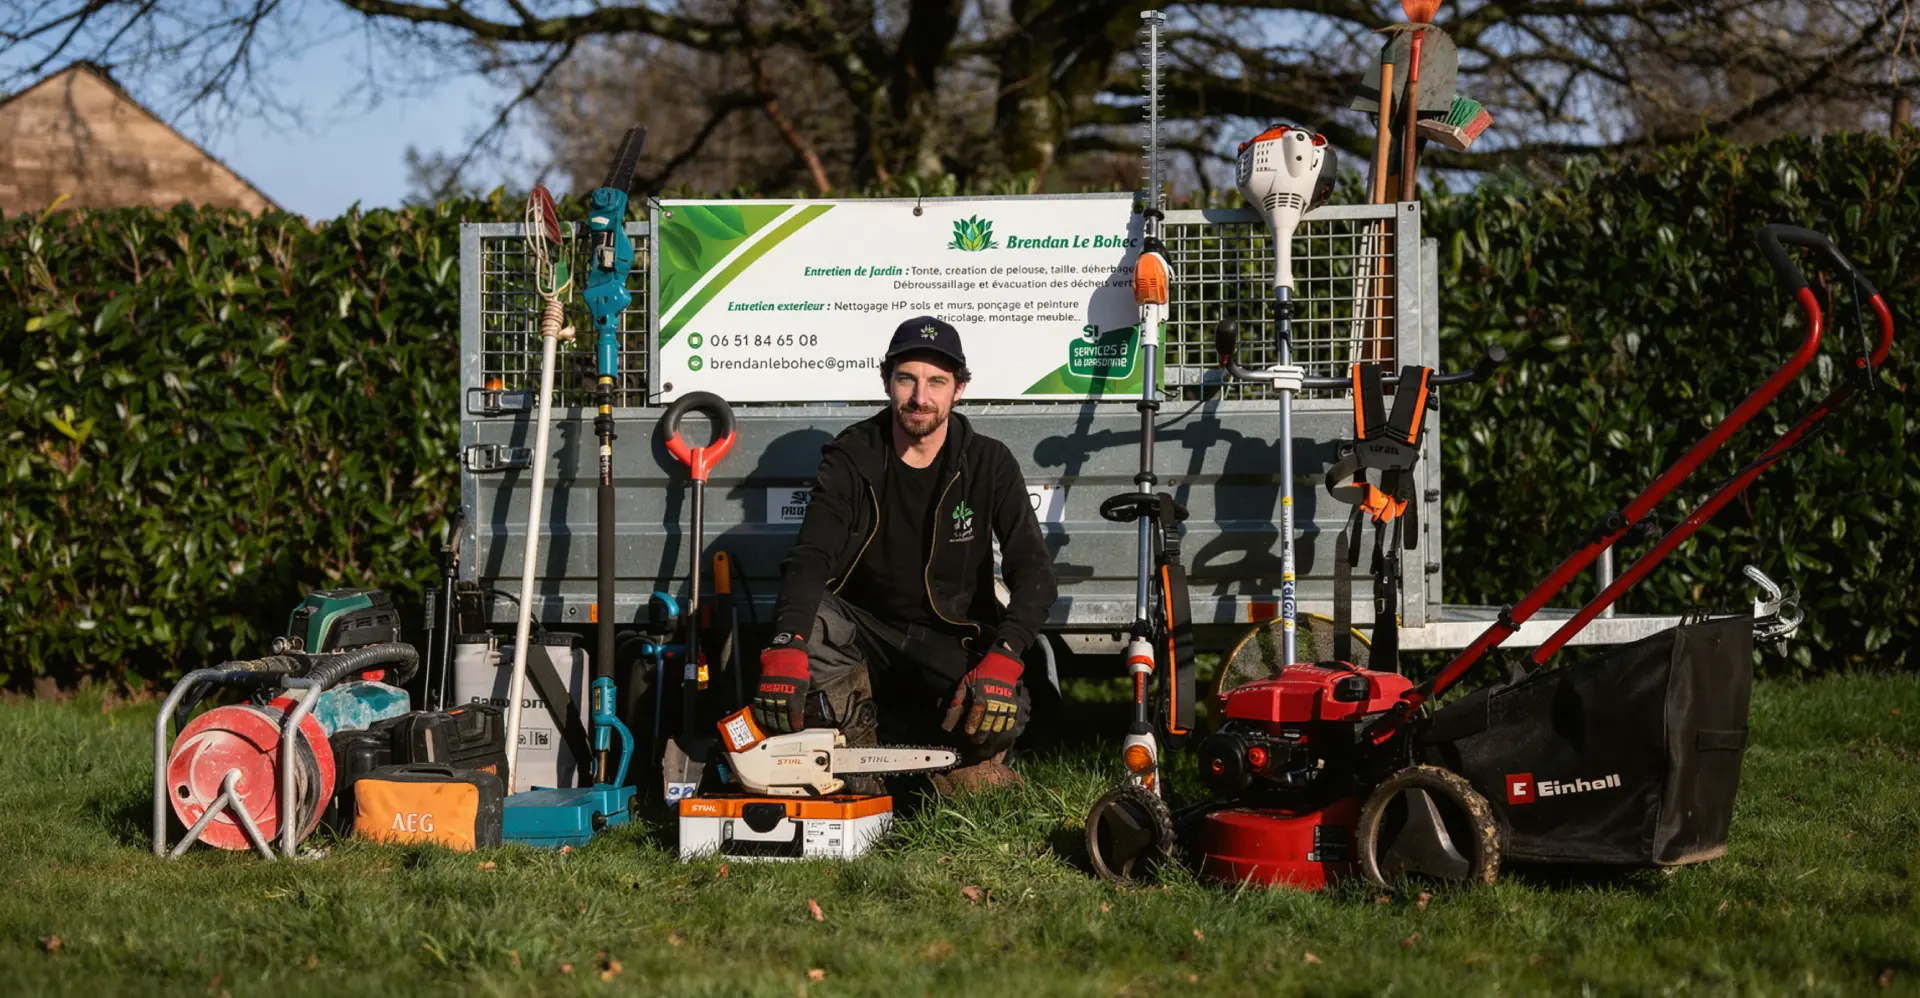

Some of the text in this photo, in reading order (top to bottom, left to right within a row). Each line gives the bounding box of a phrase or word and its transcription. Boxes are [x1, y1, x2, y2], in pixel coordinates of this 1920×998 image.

[1006, 235, 1138, 249] Brendan Le Bohec
[804, 266, 851, 277] Entretien
[854, 266, 867, 276] de
[868, 266, 903, 278] Jardin
[911, 266, 942, 276] Tonte,
[990, 264, 1003, 275] de
[1006, 264, 1049, 276] pelouse,
[893, 280, 976, 292] Débroussaillage
[979, 280, 989, 290] et
[992, 279, 1047, 289] évacuation
[1050, 279, 1068, 288] des
[1112, 279, 1134, 288] vert
[728, 301, 777, 312] Entretien
[834, 301, 889, 313] Nettoyage
[891, 301, 907, 311] HP
[910, 300, 931, 311] sols
[934, 301, 944, 310] et
[977, 301, 1022, 313] ponçage
[1024, 300, 1034, 310] et
[1036, 299, 1079, 311] peinture
[988, 313, 1035, 324] montage
[710, 334, 818, 347] 06 51 84 65 08
[710, 356, 880, 372] brendanlebohec@gmail.
[777, 758, 803, 766] STIHL
[859, 756, 891, 764] STIHL
[1537, 773, 1622, 797] Einhell
[690, 804, 718, 813] STIHL
[391, 811, 435, 833] AEG
